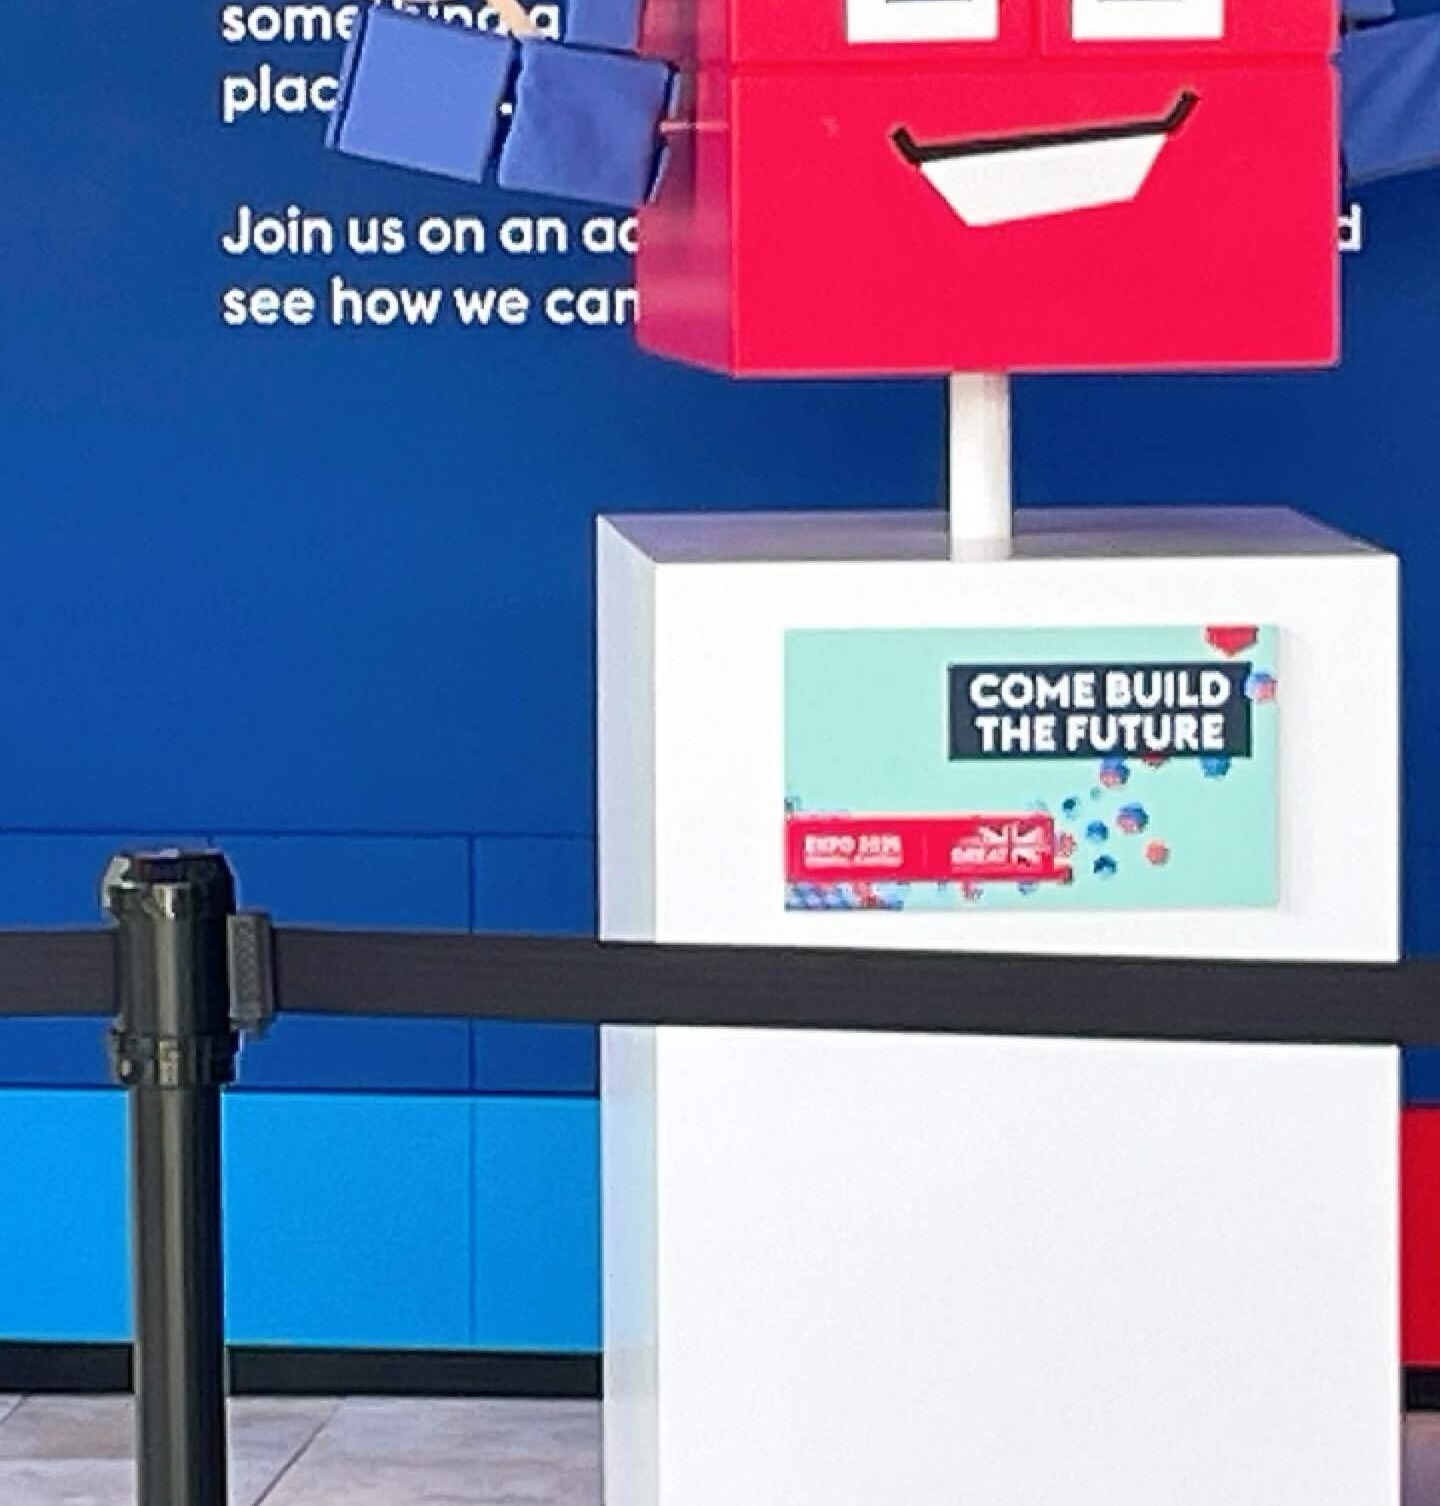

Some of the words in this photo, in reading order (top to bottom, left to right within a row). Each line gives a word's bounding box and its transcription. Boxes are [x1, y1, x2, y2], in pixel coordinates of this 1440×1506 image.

[222, 205, 332, 253] Join
[349, 218, 404, 253] us
[420, 217, 484, 252] on
[500, 218, 567, 252] an
[223, 289, 314, 324] see
[332, 276, 442, 324] how
[454, 289, 529, 324] we
[545, 288, 640, 324] can
[969, 673, 1095, 709] COME
[1106, 671, 1230, 707] BUILD
[976, 716, 1056, 751] THE
[1066, 715, 1225, 751] FUTURE
